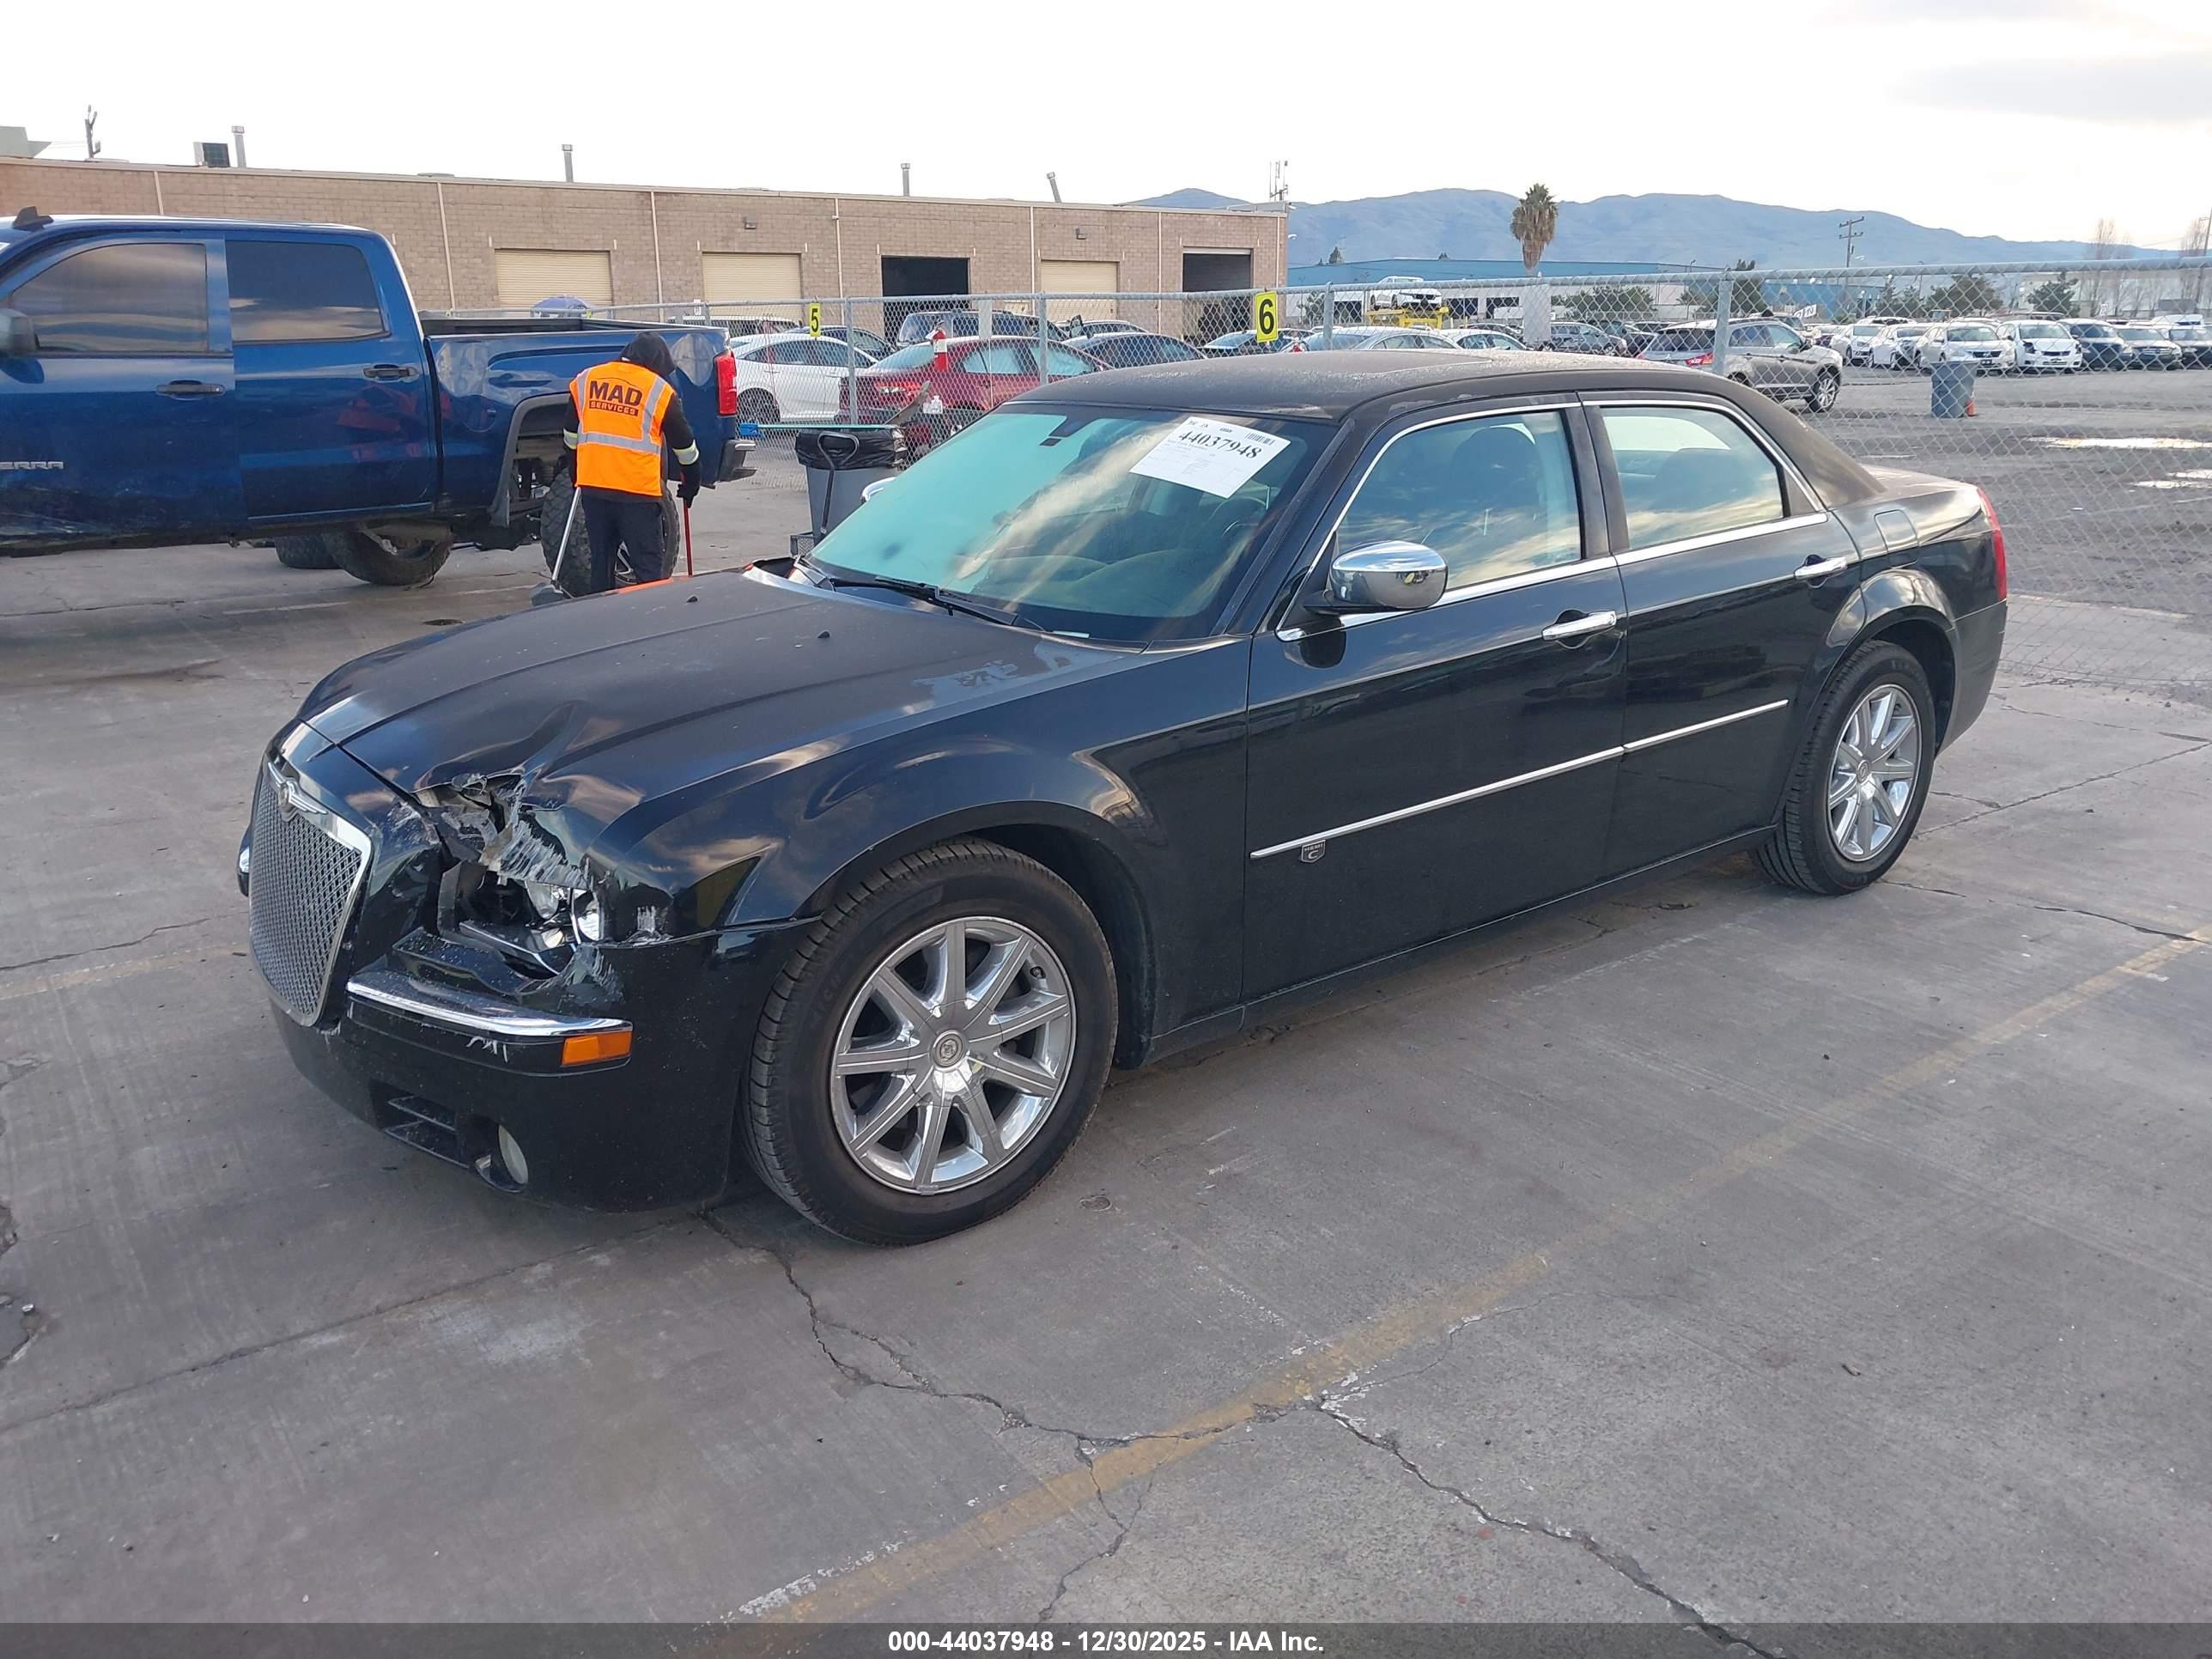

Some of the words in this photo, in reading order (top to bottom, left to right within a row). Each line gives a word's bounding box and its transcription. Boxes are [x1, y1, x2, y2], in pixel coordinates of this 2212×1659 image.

[811, 308, 818, 332] 5
[1259, 299, 1274, 334] 6
[589, 380, 642, 406] MAD
[590, 401, 636, 416] SERVICES
[1179, 430, 1262, 459] 44037948
